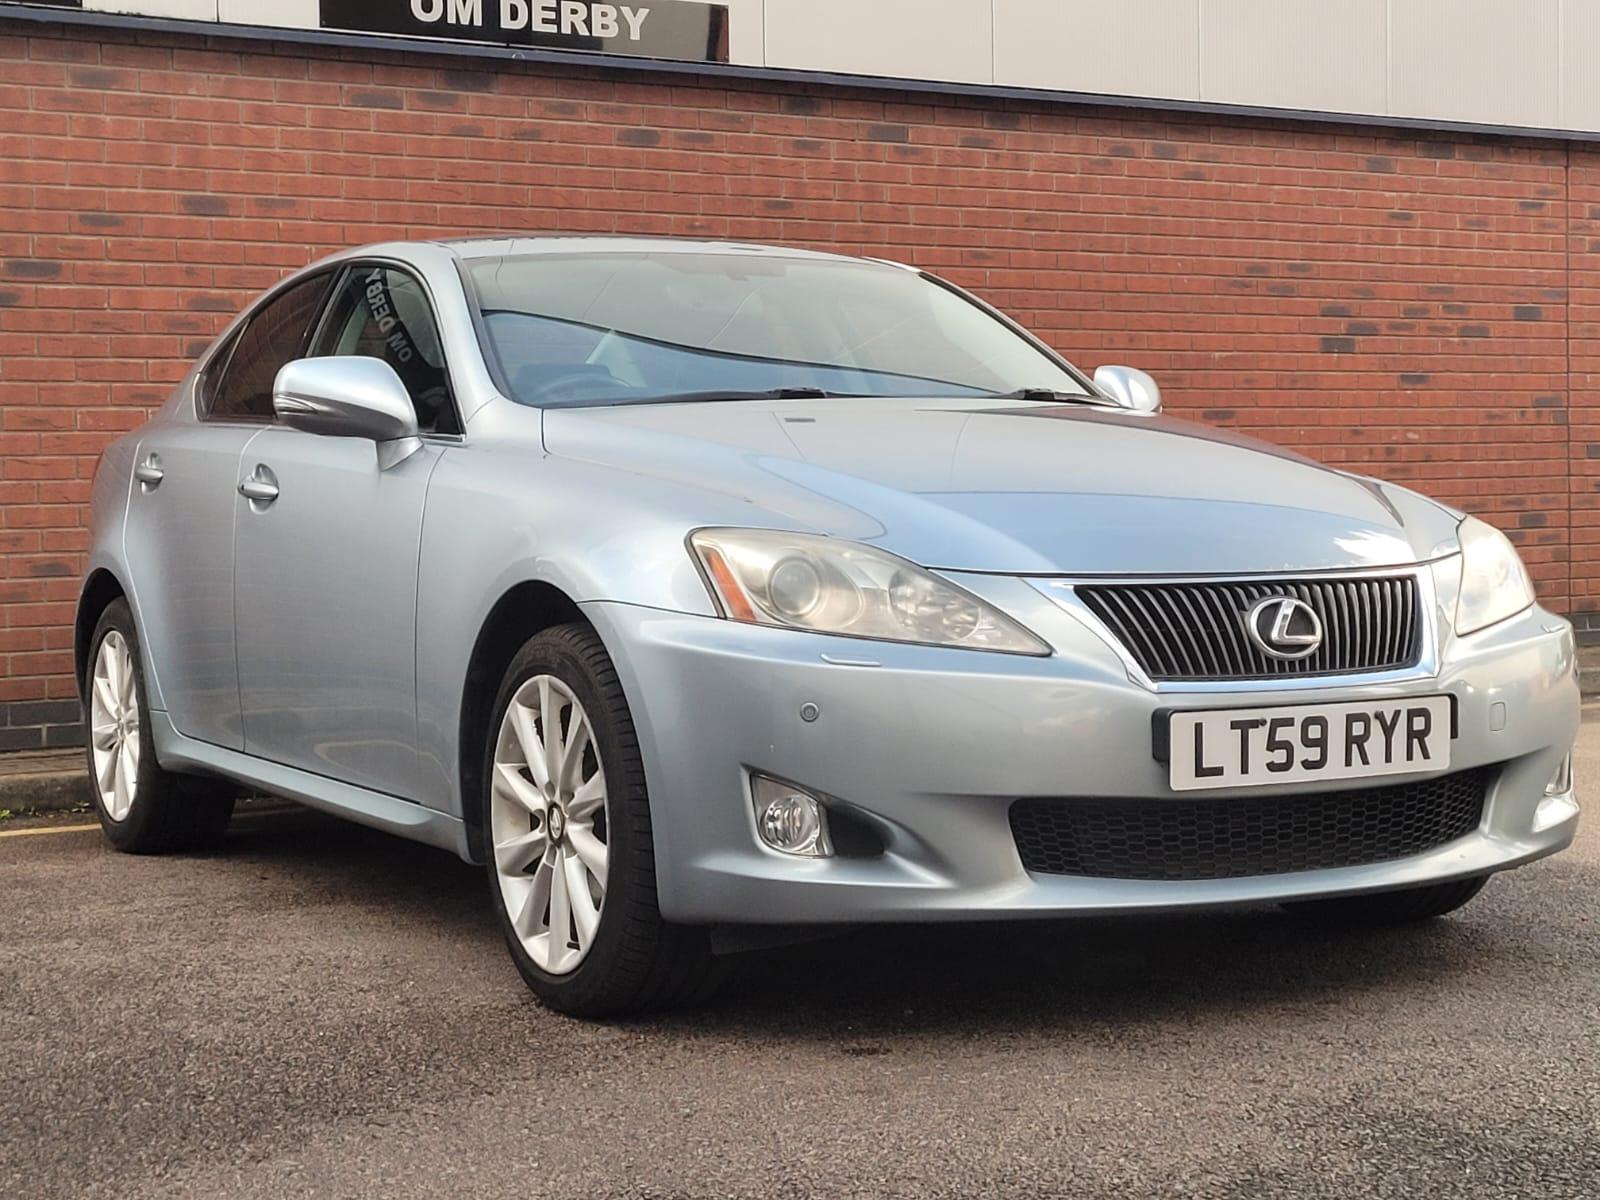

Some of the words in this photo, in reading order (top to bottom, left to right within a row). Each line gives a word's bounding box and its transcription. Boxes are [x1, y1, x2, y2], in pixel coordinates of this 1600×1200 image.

[410, 0, 482, 27] OM
[500, 0, 650, 41] DERBY
[1194, 715, 1329, 778] LT59
[1345, 707, 1432, 767] RYR
